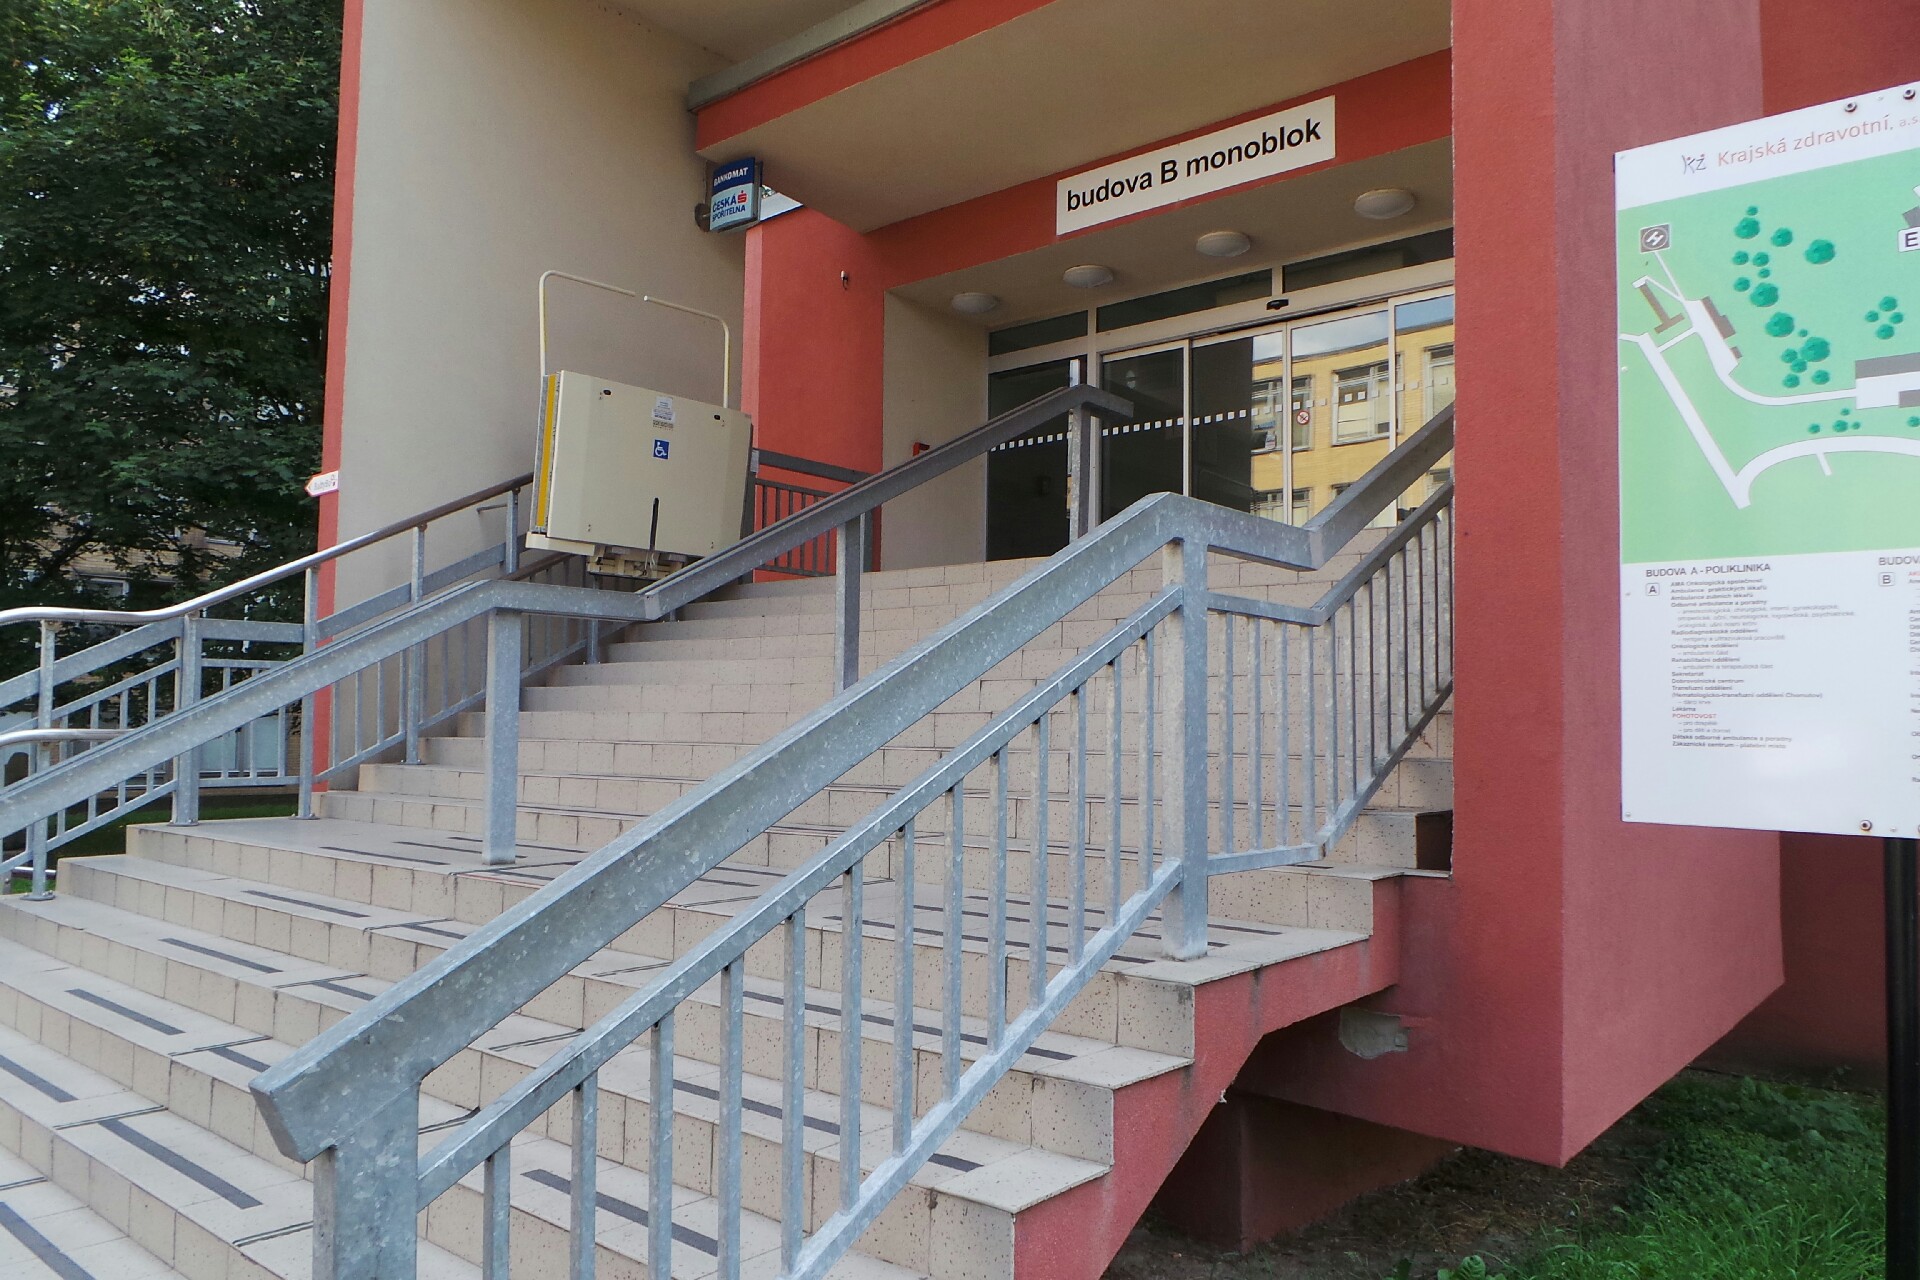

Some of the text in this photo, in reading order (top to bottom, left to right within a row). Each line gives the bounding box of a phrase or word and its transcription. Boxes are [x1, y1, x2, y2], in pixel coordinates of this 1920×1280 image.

[1718, 138, 1787, 167] Krajská
[1066, 118, 1322, 212] budova B monoblok
[713, 167, 749, 187] BANKOMAT
[1905, 231, 1919, 248] E
[1879, 556, 1920, 566] BUDOV
[1646, 568, 1687, 578] BUDOVA
[1690, 566, 1699, 576] A
[1705, 563, 1772, 575] POLIKLINIKA
[1882, 574, 1892, 585] B
[1648, 585, 1658, 594] A
